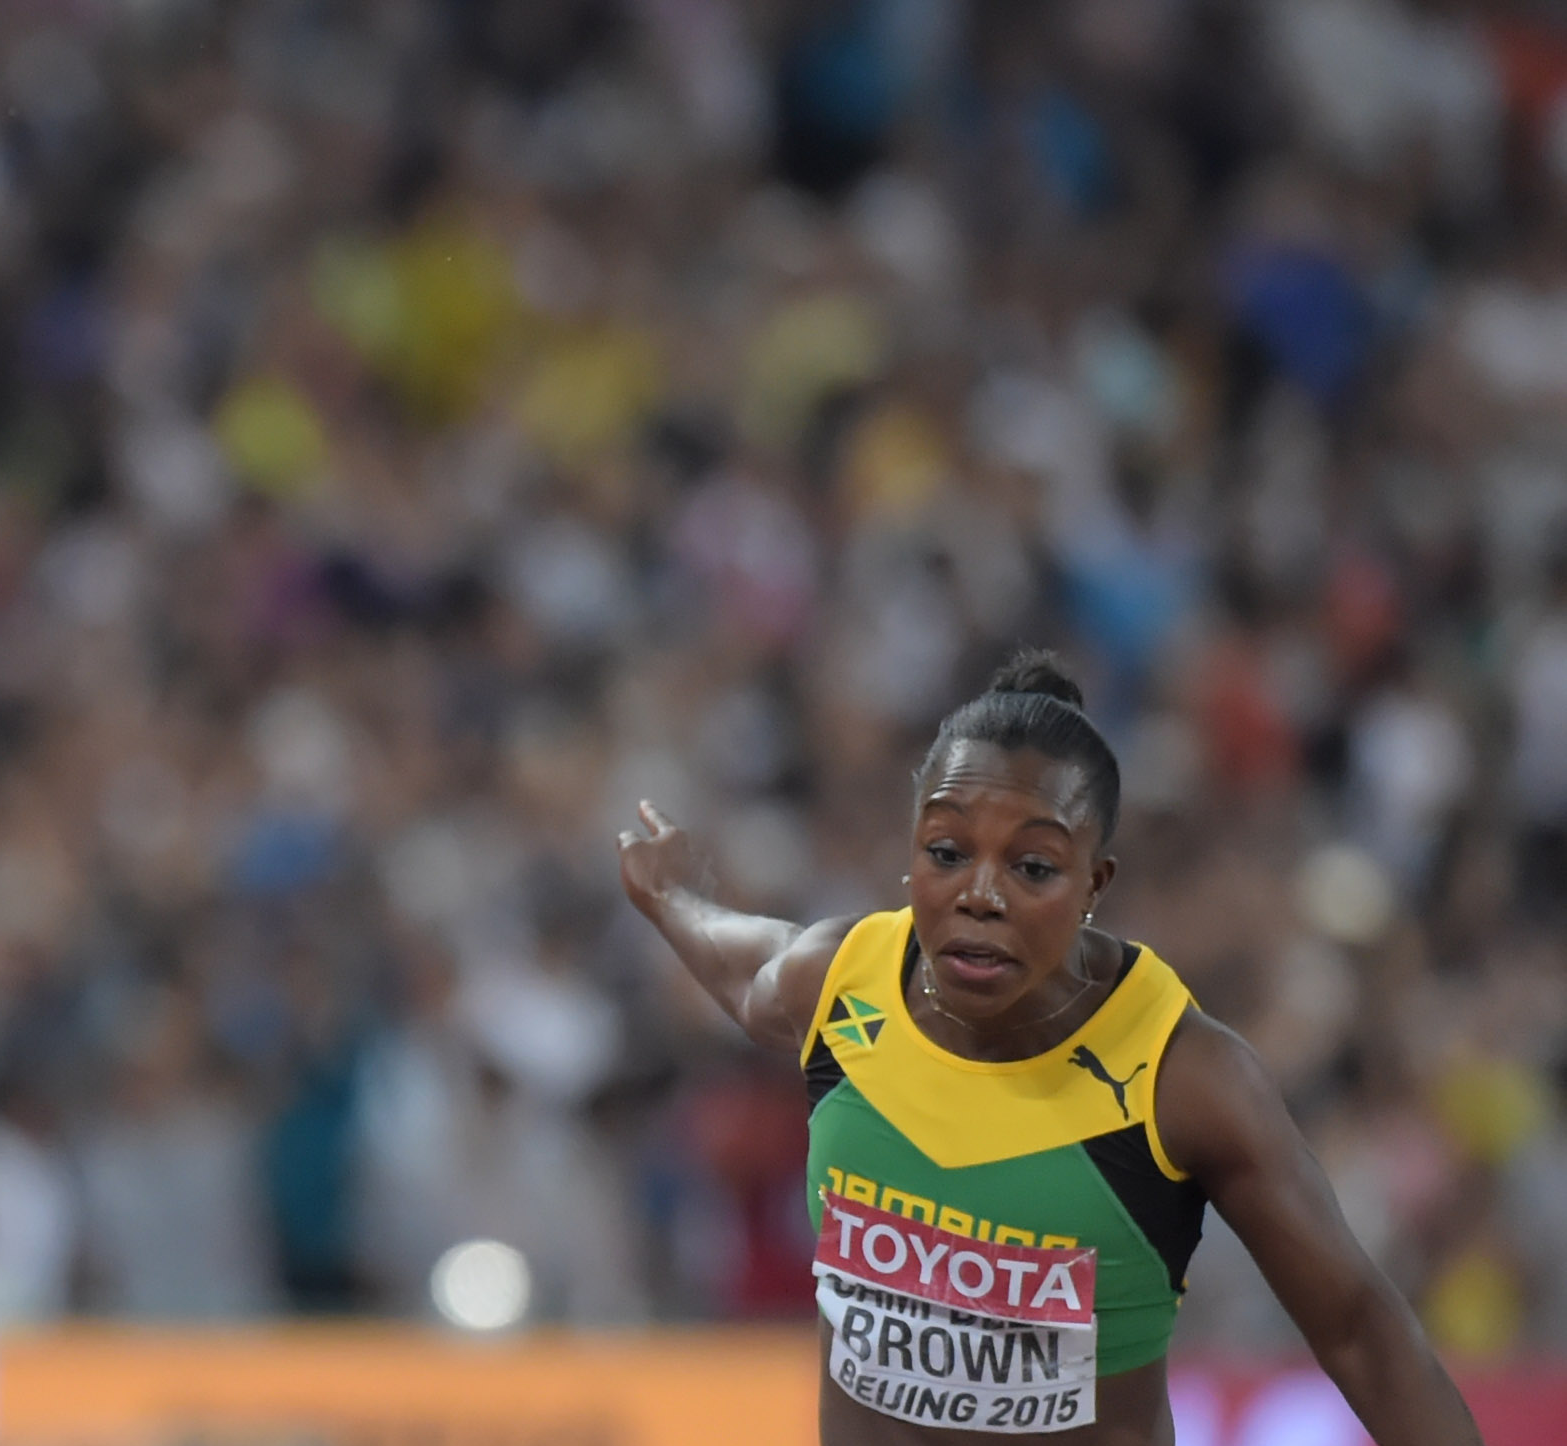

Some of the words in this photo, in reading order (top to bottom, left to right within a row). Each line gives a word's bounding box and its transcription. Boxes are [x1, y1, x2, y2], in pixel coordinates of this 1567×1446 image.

[832, 1209, 1081, 1310] TOYOTA
[842, 1305, 1059, 1384] BROWN
[838, 1358, 977, 1422] BEIJING
[986, 1388, 1081, 1426] 2015
